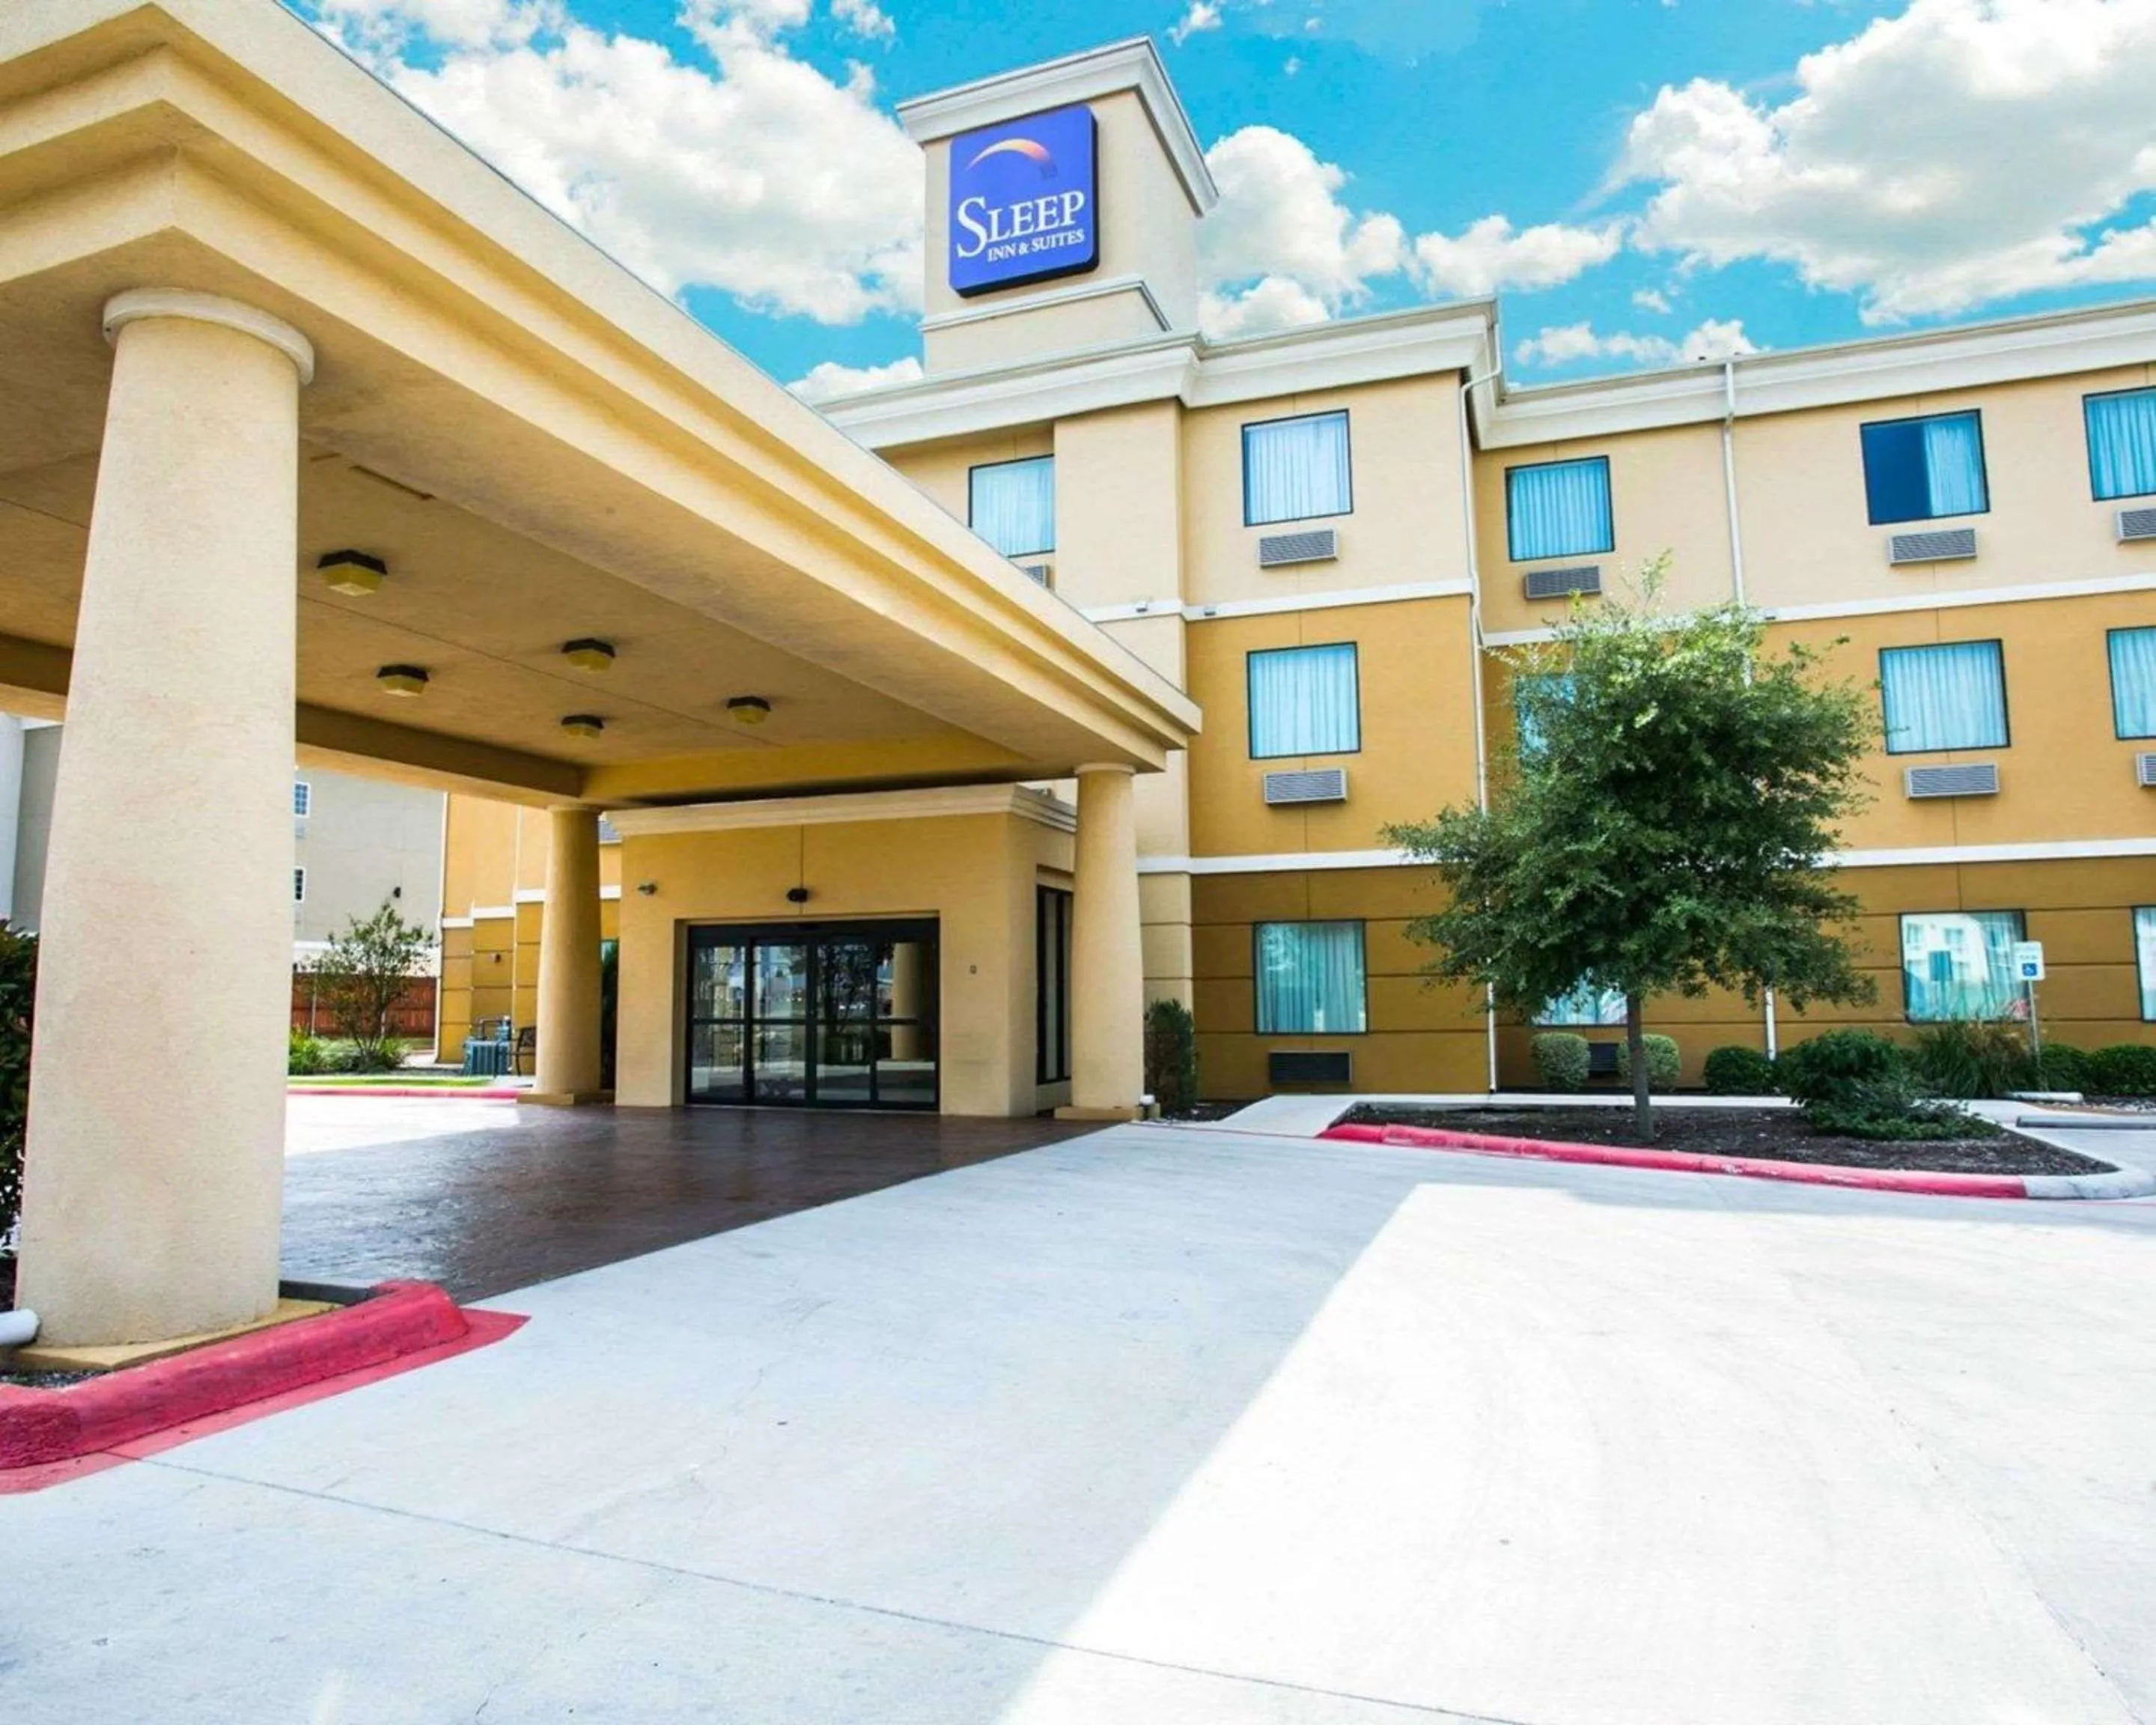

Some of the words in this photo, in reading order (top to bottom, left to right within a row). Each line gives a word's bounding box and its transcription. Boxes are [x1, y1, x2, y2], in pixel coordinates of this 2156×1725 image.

[957, 190, 1085, 258] SLEEP
[987, 243, 1017, 262] INN
[1019, 242, 1029, 255] &
[1032, 228, 1085, 251] SUITES
